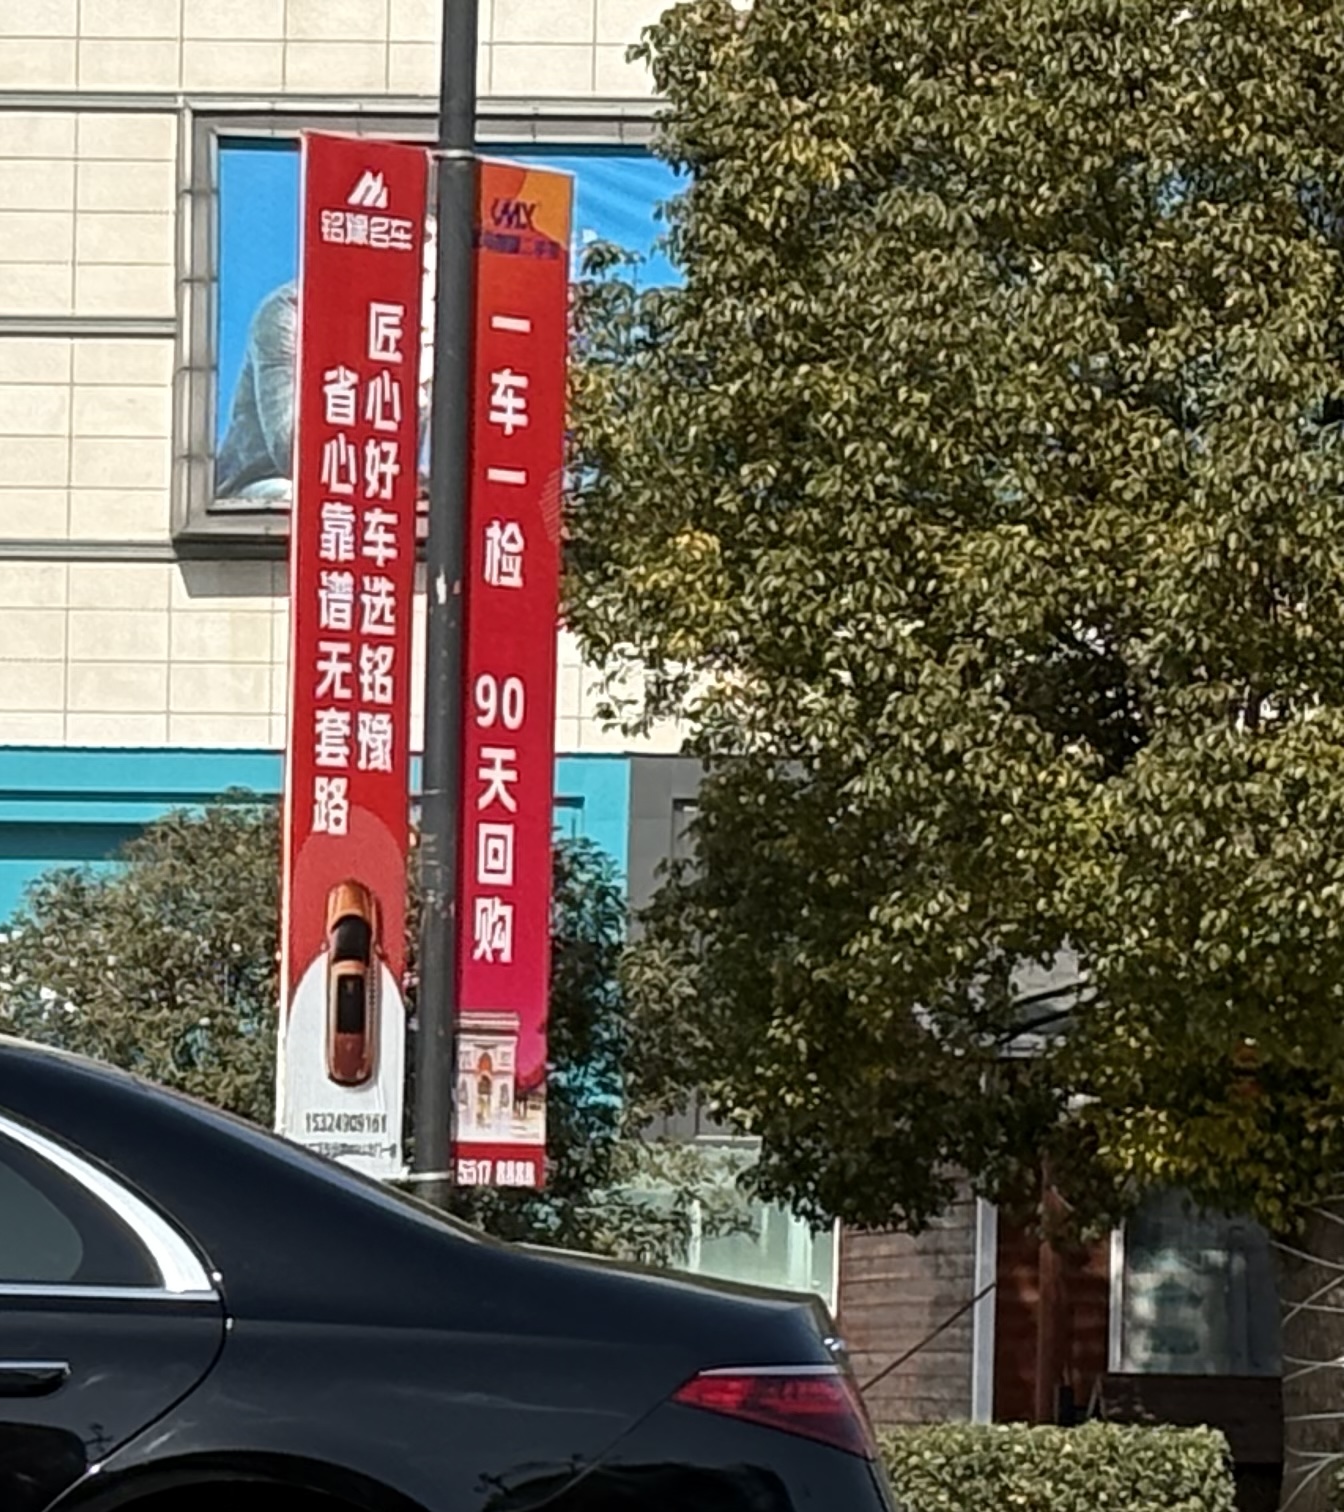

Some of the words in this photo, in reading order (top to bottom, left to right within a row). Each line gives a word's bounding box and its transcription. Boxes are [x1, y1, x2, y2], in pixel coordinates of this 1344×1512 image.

[312, 365, 359, 836] 省心靠谱无套路
[357, 302, 404, 772] 匠心好车选铭豫
[484, 315, 531, 588] 一车一检
[473, 674, 525, 963] 90天回购
